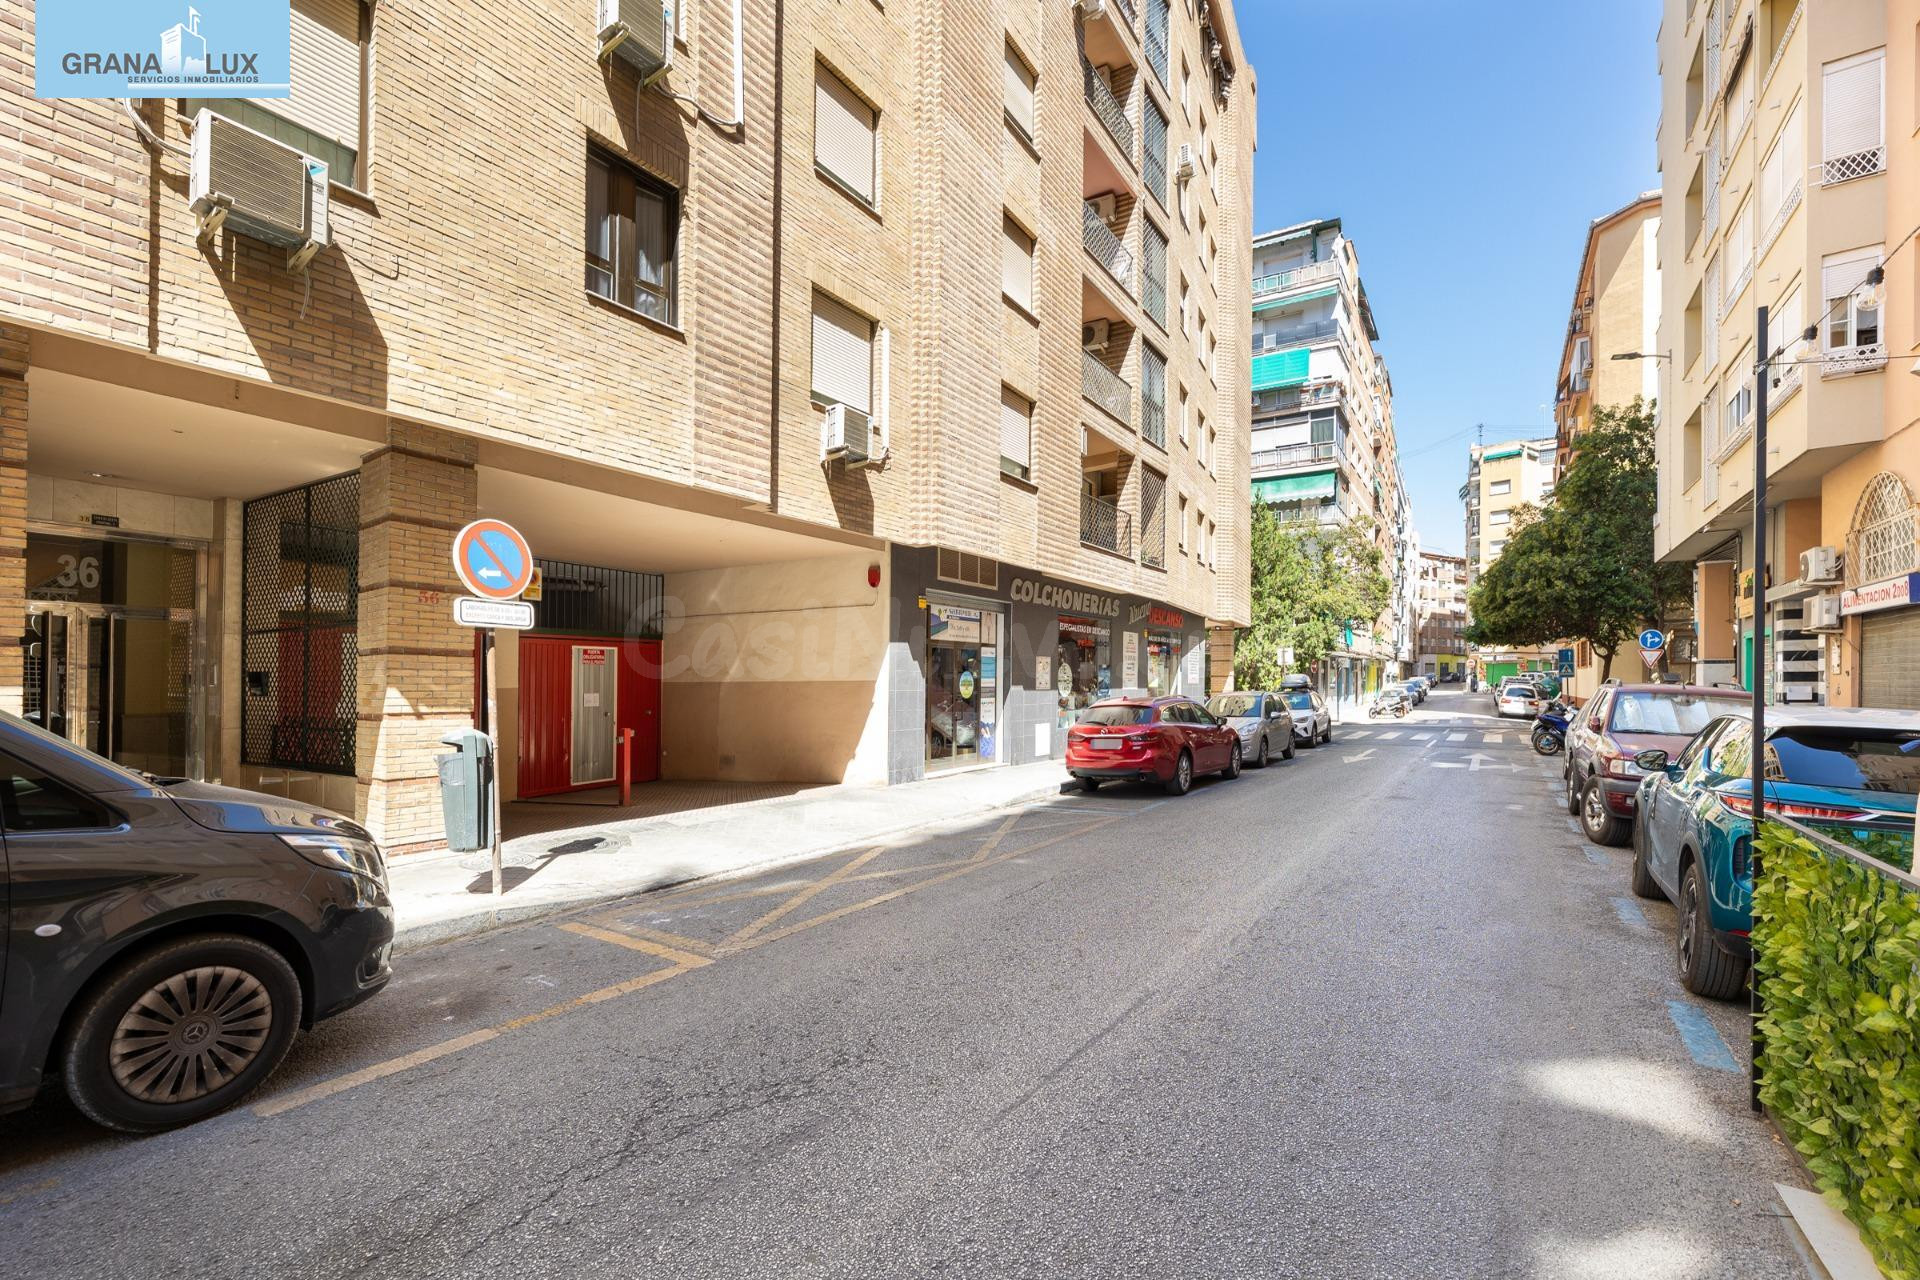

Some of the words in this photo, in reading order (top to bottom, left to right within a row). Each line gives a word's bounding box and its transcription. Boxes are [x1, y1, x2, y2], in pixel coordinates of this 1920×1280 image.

[57, 554, 99, 588] 36
[1010, 578, 1120, 617] COLCHONERÍAS
[1843, 587, 1891, 609] ALIMENTACION
[1147, 607, 1184, 628] DESCANSO
